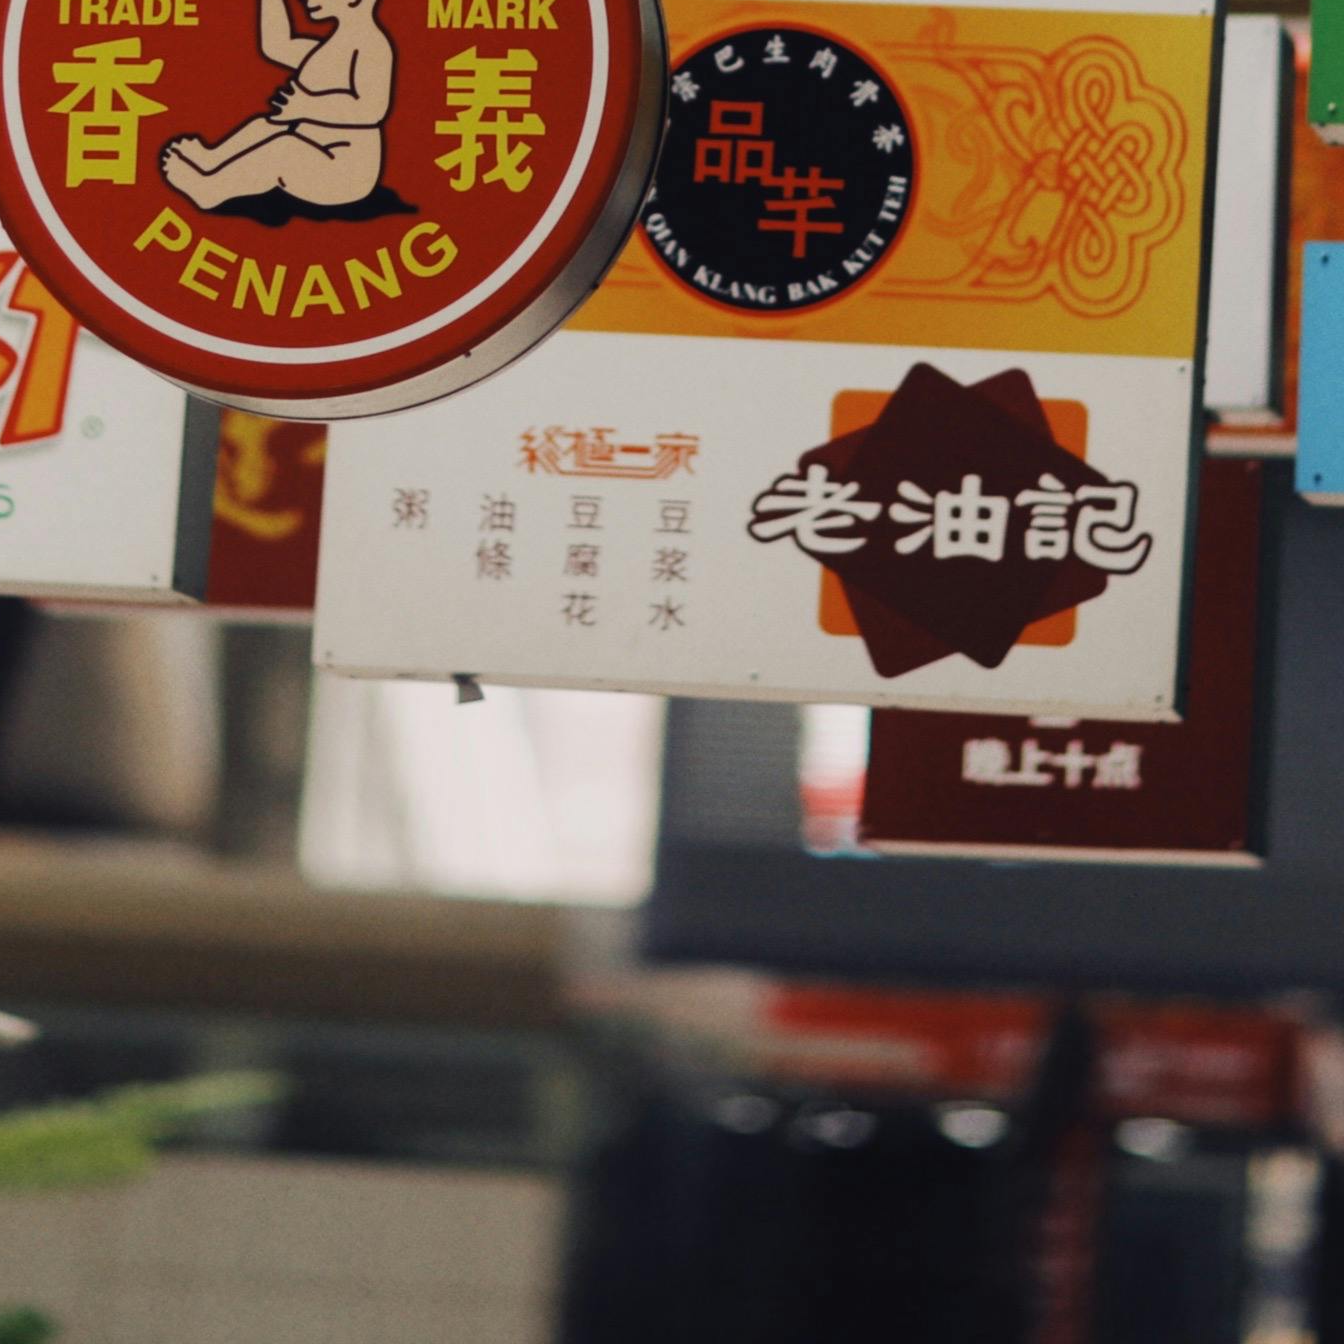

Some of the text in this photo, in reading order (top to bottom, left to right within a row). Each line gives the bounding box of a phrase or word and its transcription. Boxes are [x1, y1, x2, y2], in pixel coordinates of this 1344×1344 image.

[47, 36, 546, 193] 香 義
[133, 207, 460, 319] PENANG
[693, 264, 776, 304] KLANG
[787, 270, 839, 302] BAK
[842, 228, 885, 276] KUT
[878, 175, 908, 222] TEH
[746, 463, 1152, 576] 老油記
